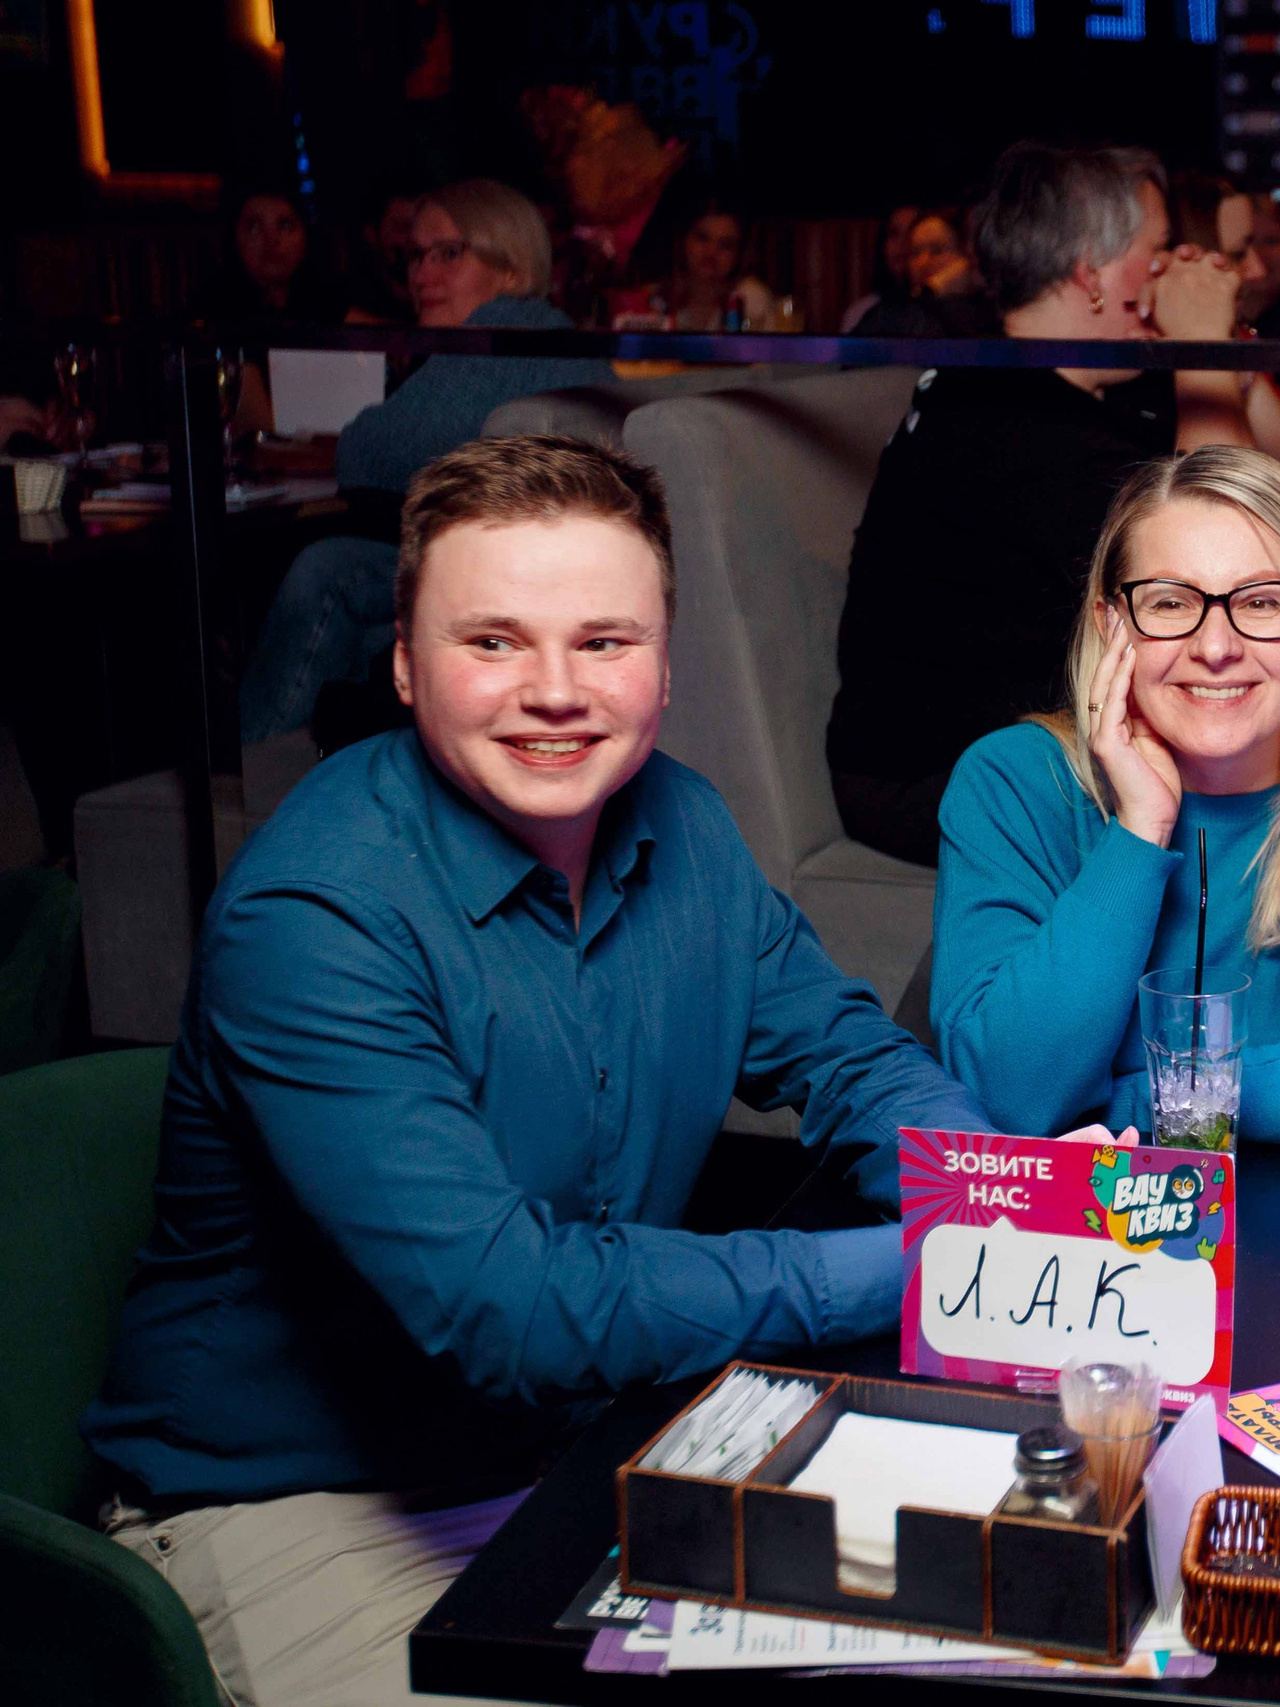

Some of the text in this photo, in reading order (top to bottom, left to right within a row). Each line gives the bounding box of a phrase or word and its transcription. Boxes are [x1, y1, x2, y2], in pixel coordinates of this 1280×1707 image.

[943, 1150, 1054, 1180] ЗОВИТЕ
[968, 1183, 1030, 1210] НАС:
[1112, 1173, 1169, 1211] ВАУ
[1127, 1202, 1194, 1238] КВИЗ
